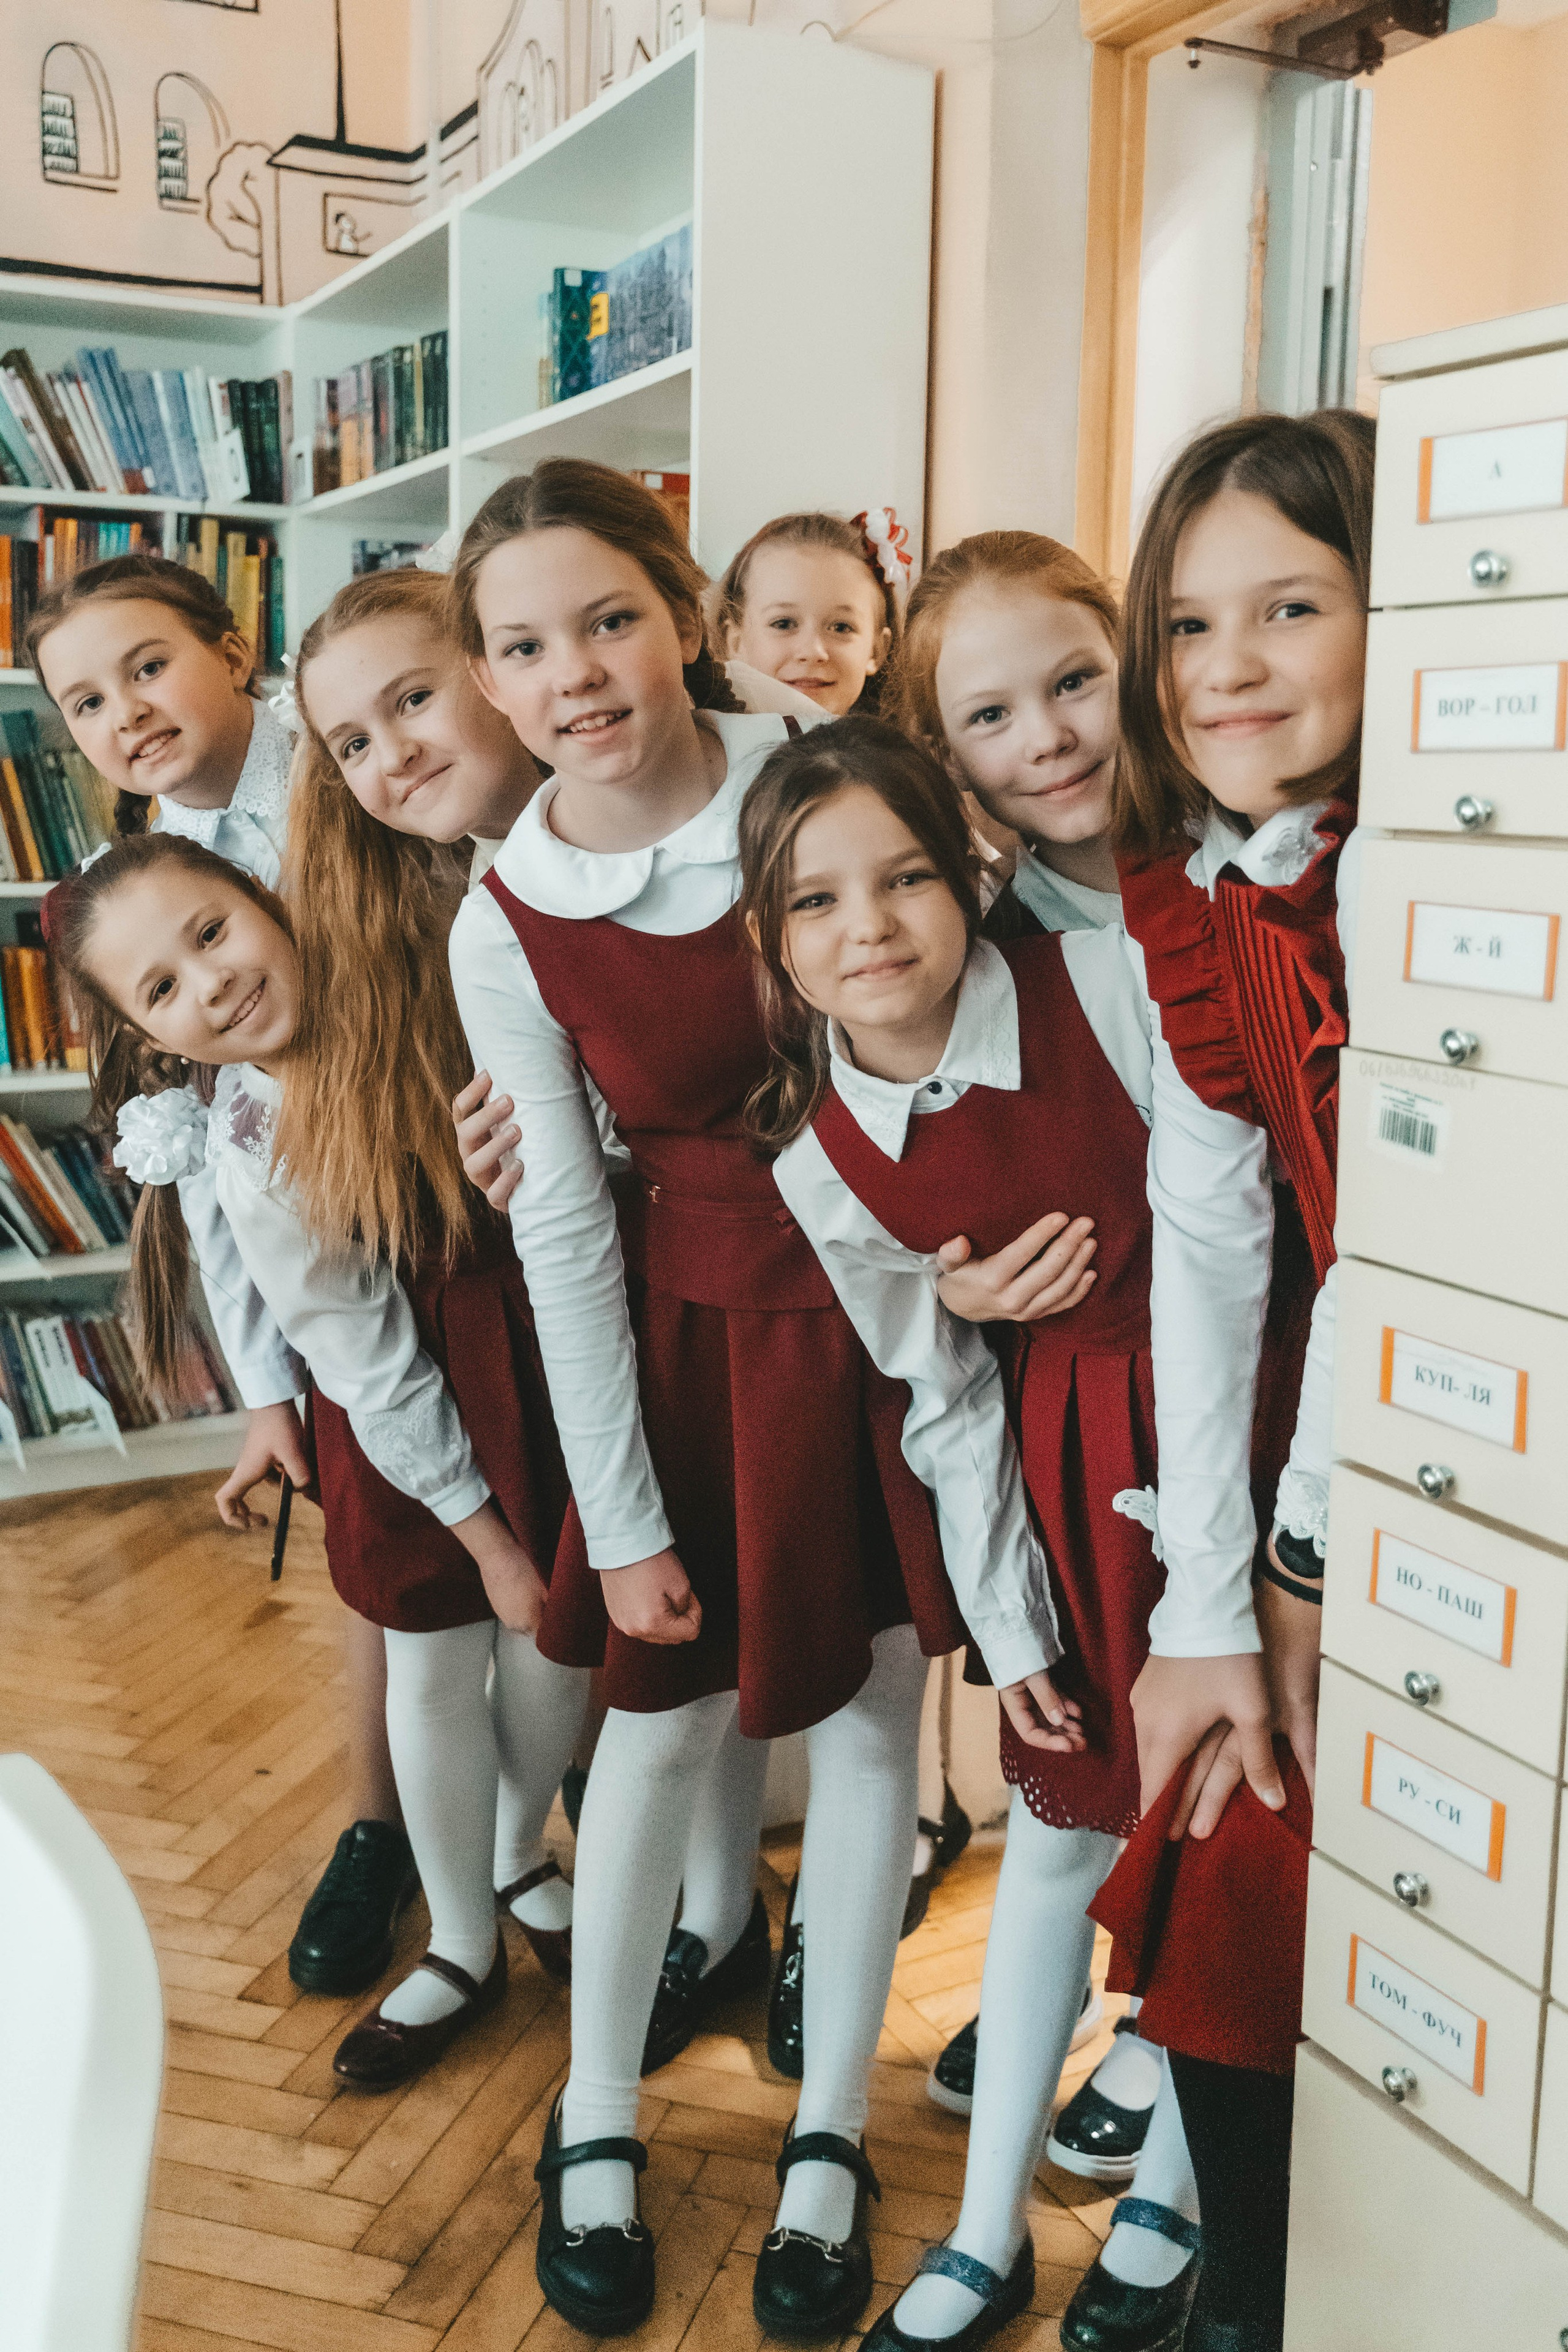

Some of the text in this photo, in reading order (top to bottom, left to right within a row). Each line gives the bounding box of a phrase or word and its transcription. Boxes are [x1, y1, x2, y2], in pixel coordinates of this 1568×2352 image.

[1488, 461, 1502, 480] А
[1438, 697, 1475, 717] ВОР
[1495, 694, 1537, 715] ГОЛ
[1453, 935, 1471, 954] Ж
[1464, 1383, 1491, 1406] ЛЯ
[1396, 1566, 1422, 1591] НО
[1438, 1584, 1483, 1619] ПАШ
[1398, 1776, 1421, 1800] РУ
[1435, 1799, 1461, 1825] СИ
[1369, 1971, 1408, 2010] ТОМ
[1422, 2011, 1463, 2048] ФУЧ
